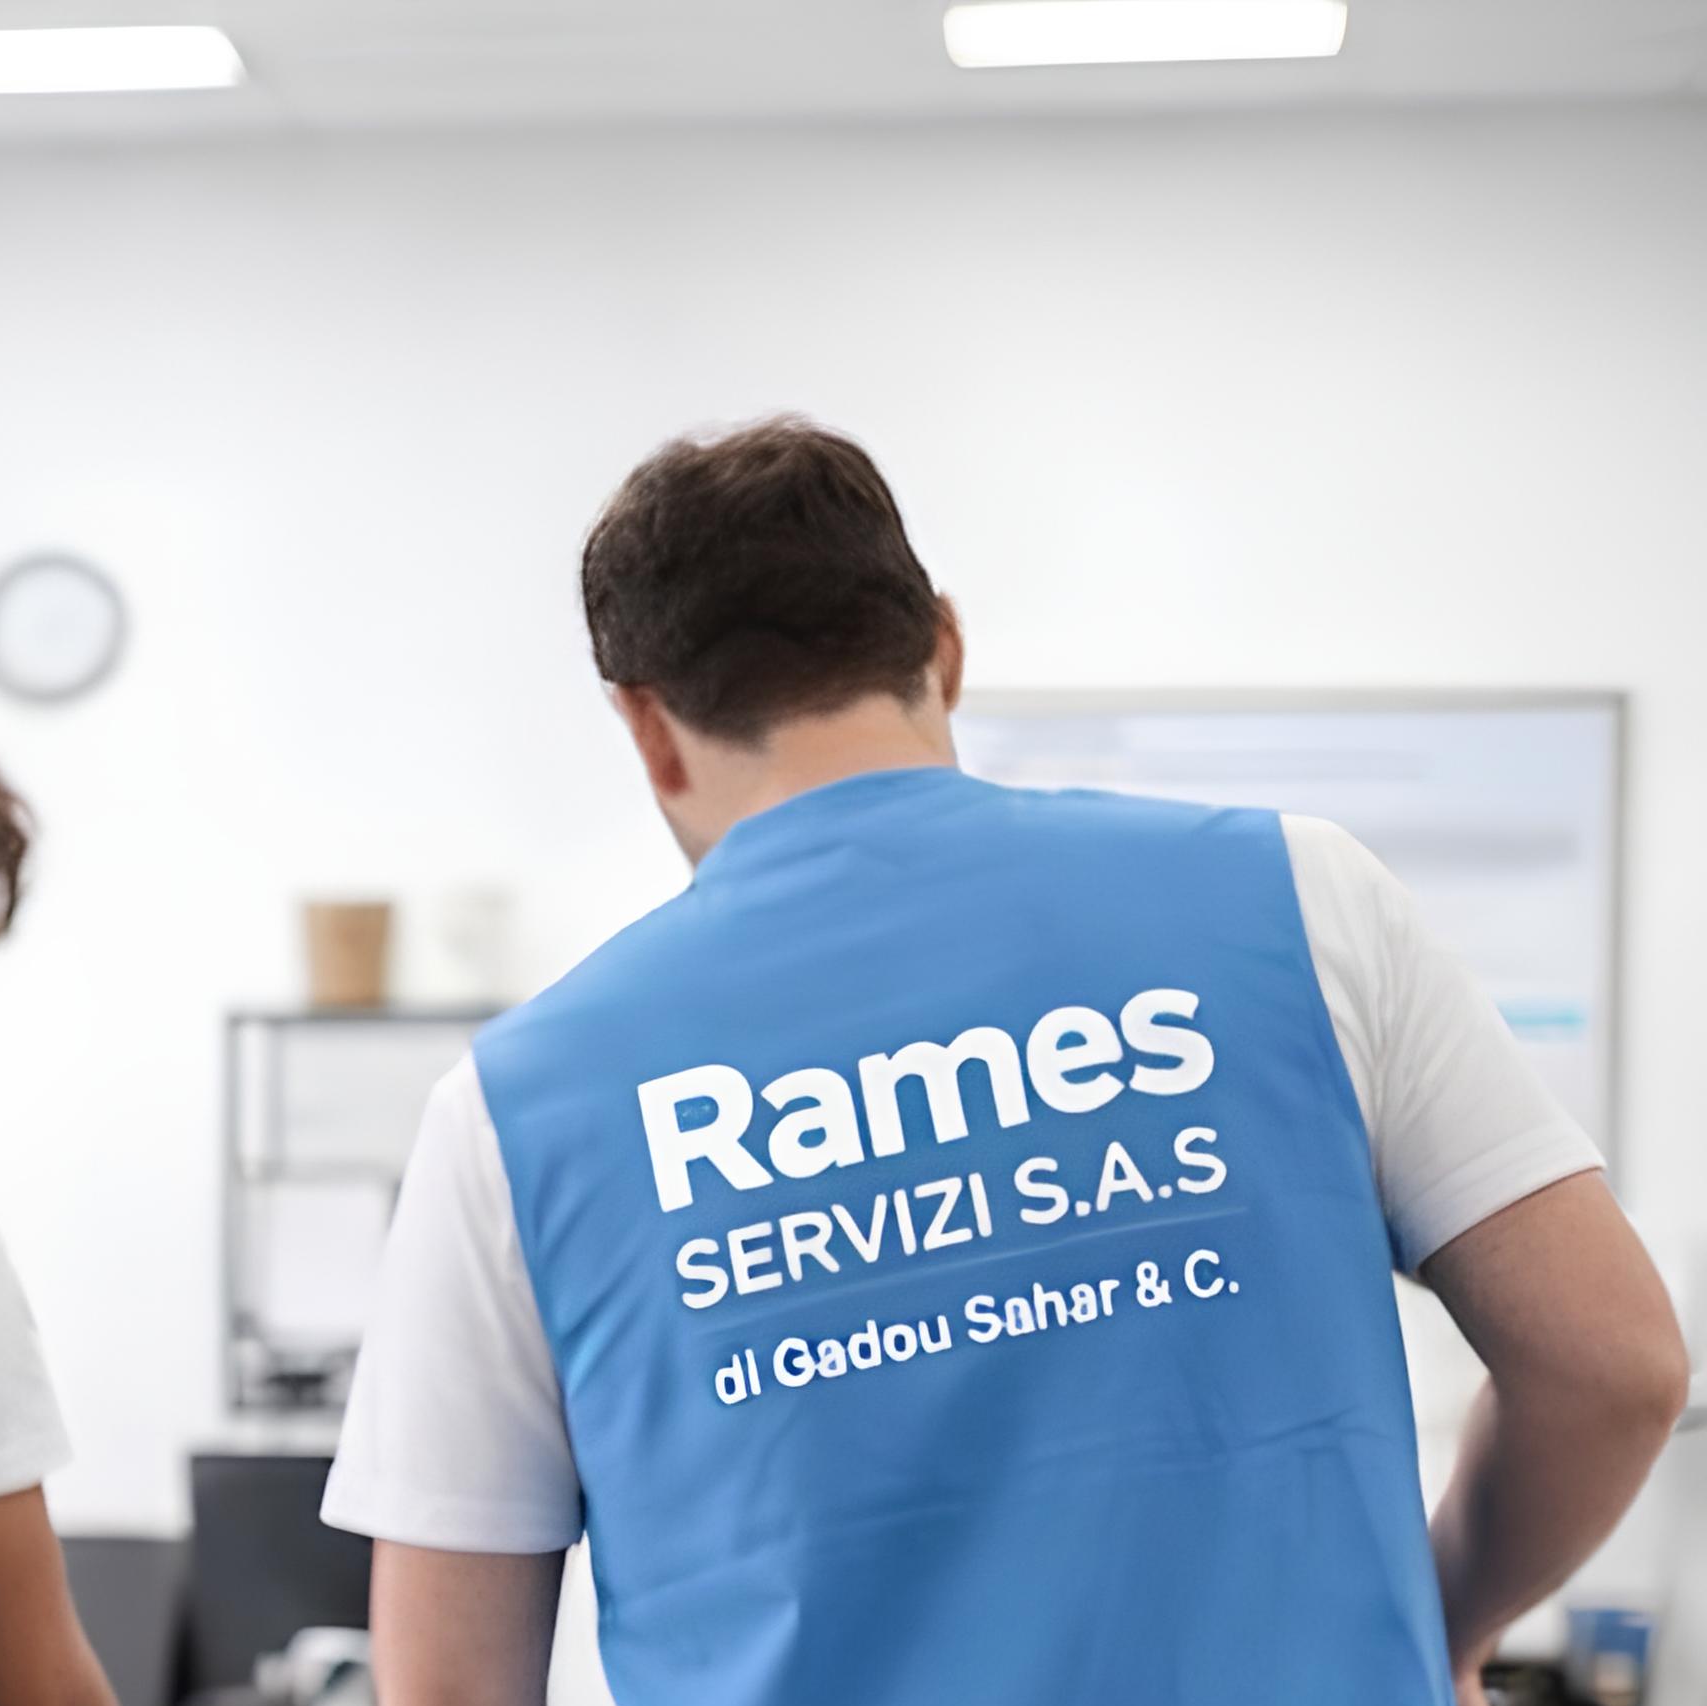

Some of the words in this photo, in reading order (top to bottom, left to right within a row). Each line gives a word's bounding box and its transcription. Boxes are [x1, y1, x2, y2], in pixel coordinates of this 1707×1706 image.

[637, 988, 1215, 1213] Rames
[675, 1172, 992, 1310] SERVIZI
[1012, 1126, 1229, 1226] S.A.S
[773, 1314, 952, 1388] Gadou
[1136, 1261, 1173, 1308] &
[1184, 1250, 1240, 1299] C.
